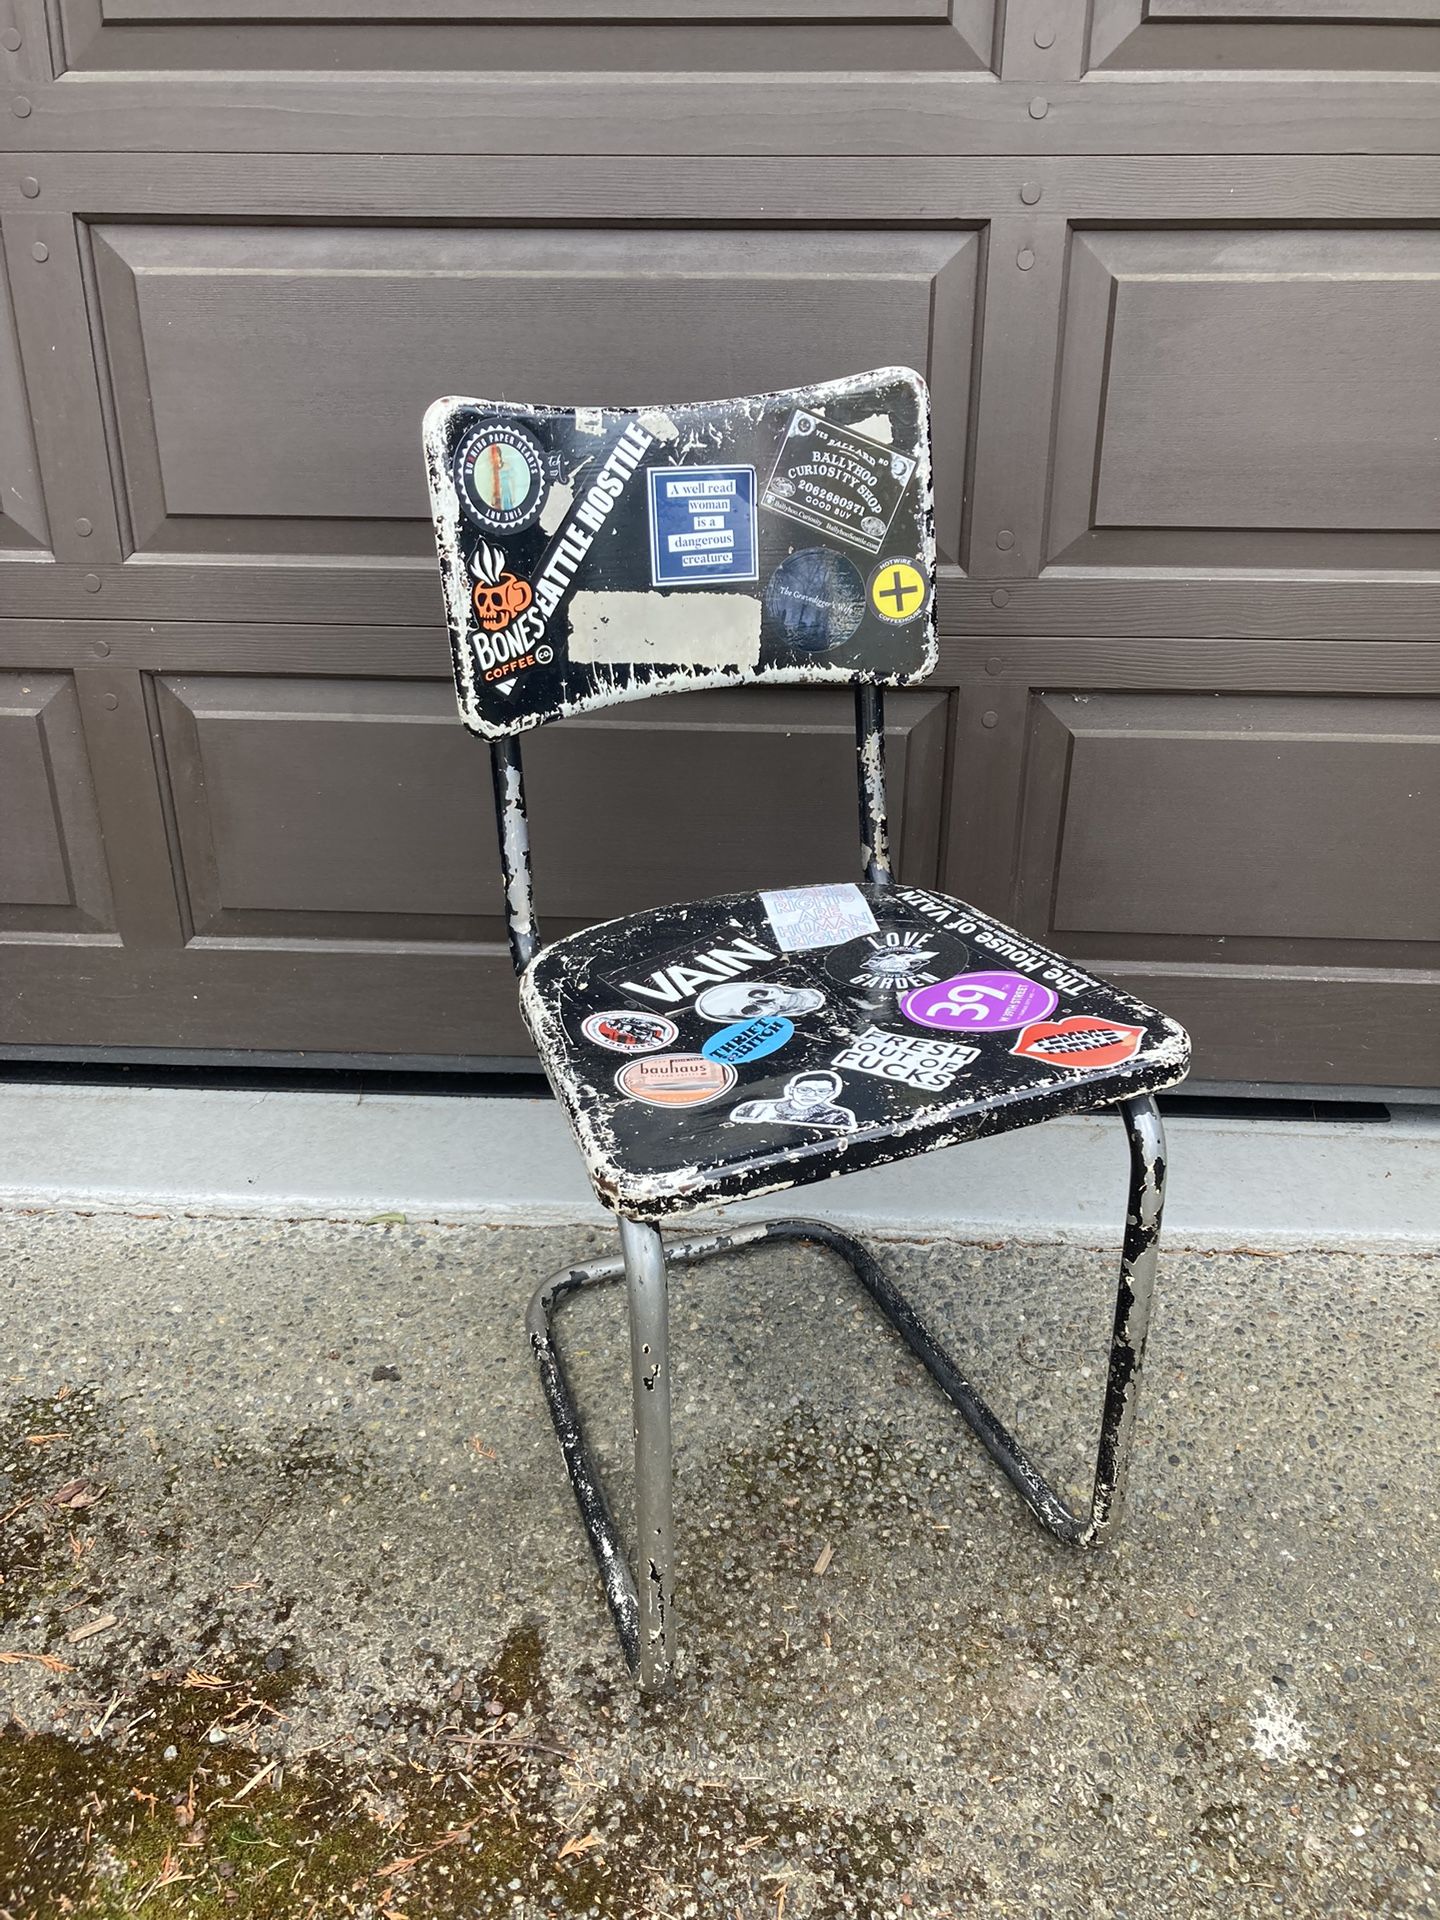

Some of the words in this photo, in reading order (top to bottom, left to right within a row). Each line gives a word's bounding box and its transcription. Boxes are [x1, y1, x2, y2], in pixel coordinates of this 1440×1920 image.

[815, 429, 829, 440] YES
[465, 438, 487, 475] BURNING
[489, 433, 515, 444] PAPER
[517, 439, 538, 474] HEARTS
[827, 439, 877, 466] BALLARD
[878, 457, 889, 467] NO
[812, 451, 878, 487] BALLYHOO
[671, 484, 679, 495] A
[683, 482, 705, 494] well
[708, 481, 733, 494] read
[788, 464, 860, 488] CURIOSITY
[857, 484, 883, 514] SHOP
[798, 479, 866, 517] 2062680371
[485, 508, 501, 521] ART
[505, 507, 523, 521] FINE
[690, 501, 728, 510] woman
[805, 496, 832, 512] GOOD
[834, 507, 852, 520] BUY
[535, 523, 594, 622] EATTLE
[576, 421, 655, 533] HOSTILE
[697, 517, 707, 527] is
[709, 519, 716, 527] a
[675, 535, 732, 550] dangerous
[683, 553, 733, 565] creature.
[879, 558, 912, 570] HOTWIRE
[780, 586, 793, 597] The
[793, 589, 837, 609] Gravedigger's
[838, 603, 853, 615] Wife
[878, 607, 923, 624] COFFEEHOUSE
[473, 606, 545, 671] BONES
[485, 655, 536, 681] COFFEE
[774, 893, 856, 914] RIGHTS
[799, 905, 843, 924] ARE
[895, 889, 953, 922] VAIN
[777, 912, 873, 937] HUMAN
[787, 926, 872, 947] RIGHTS
[943, 915, 978, 935] of
[866, 931, 935, 950] LOVE
[974, 931, 1047, 973] House
[619, 937, 778, 1003] VAIN
[850, 971, 942, 990] GARDEN
[1042, 969, 1092, 997] The
[926, 984, 1008, 1021] 39
[604, 1039, 657, 1050] bauhaus
[708, 1017, 770, 1063] THRIFT
[736, 1020, 785, 1058] BITCH
[865, 1031, 976, 1061] FRESH
[640, 1060, 707, 1075] bauhaus
[837, 1051, 951, 1086] FUCKS
[858, 1042, 913, 1061] OUT
[920, 1058, 958, 1071] OF
